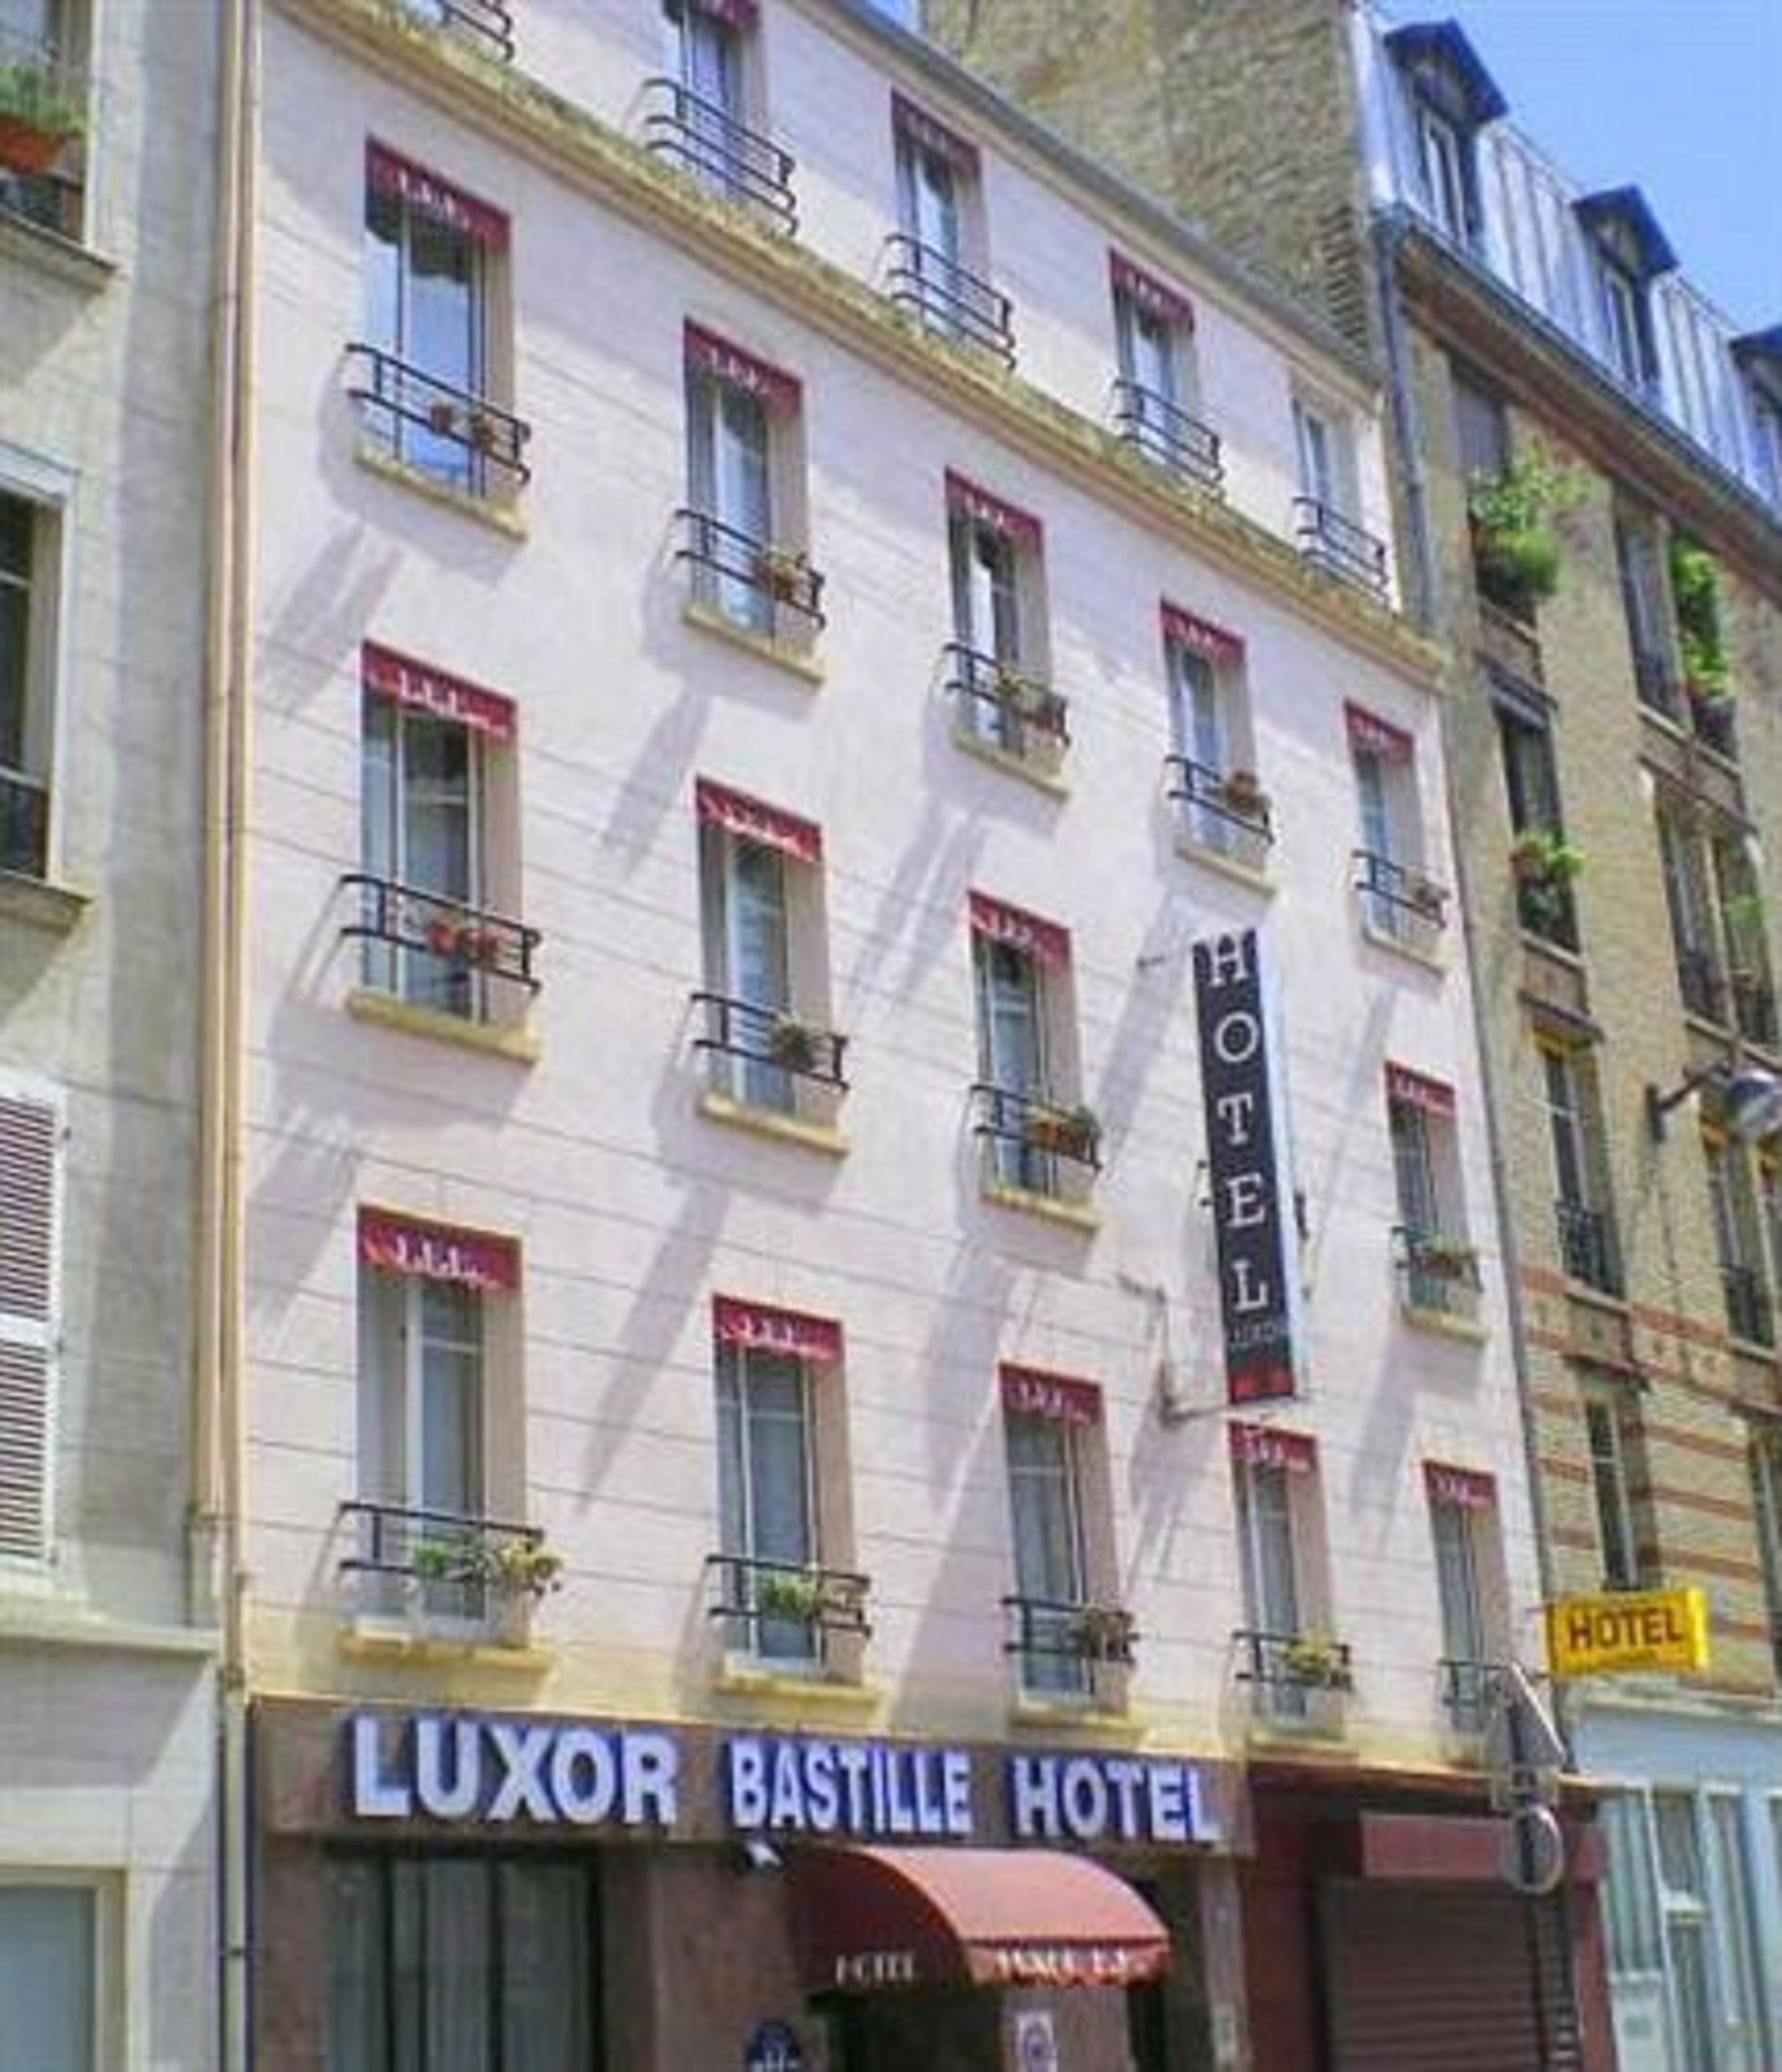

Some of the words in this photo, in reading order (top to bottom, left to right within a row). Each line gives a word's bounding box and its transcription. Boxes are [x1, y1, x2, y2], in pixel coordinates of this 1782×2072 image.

[1208, 932, 1270, 1312] HOTEL
[1568, 1607, 1684, 1651] HOTEL
[353, 1713, 678, 1824] LUXOR
[730, 1738, 973, 1834] BASTILLE
[1012, 1755, 1225, 1842] HOTEL
